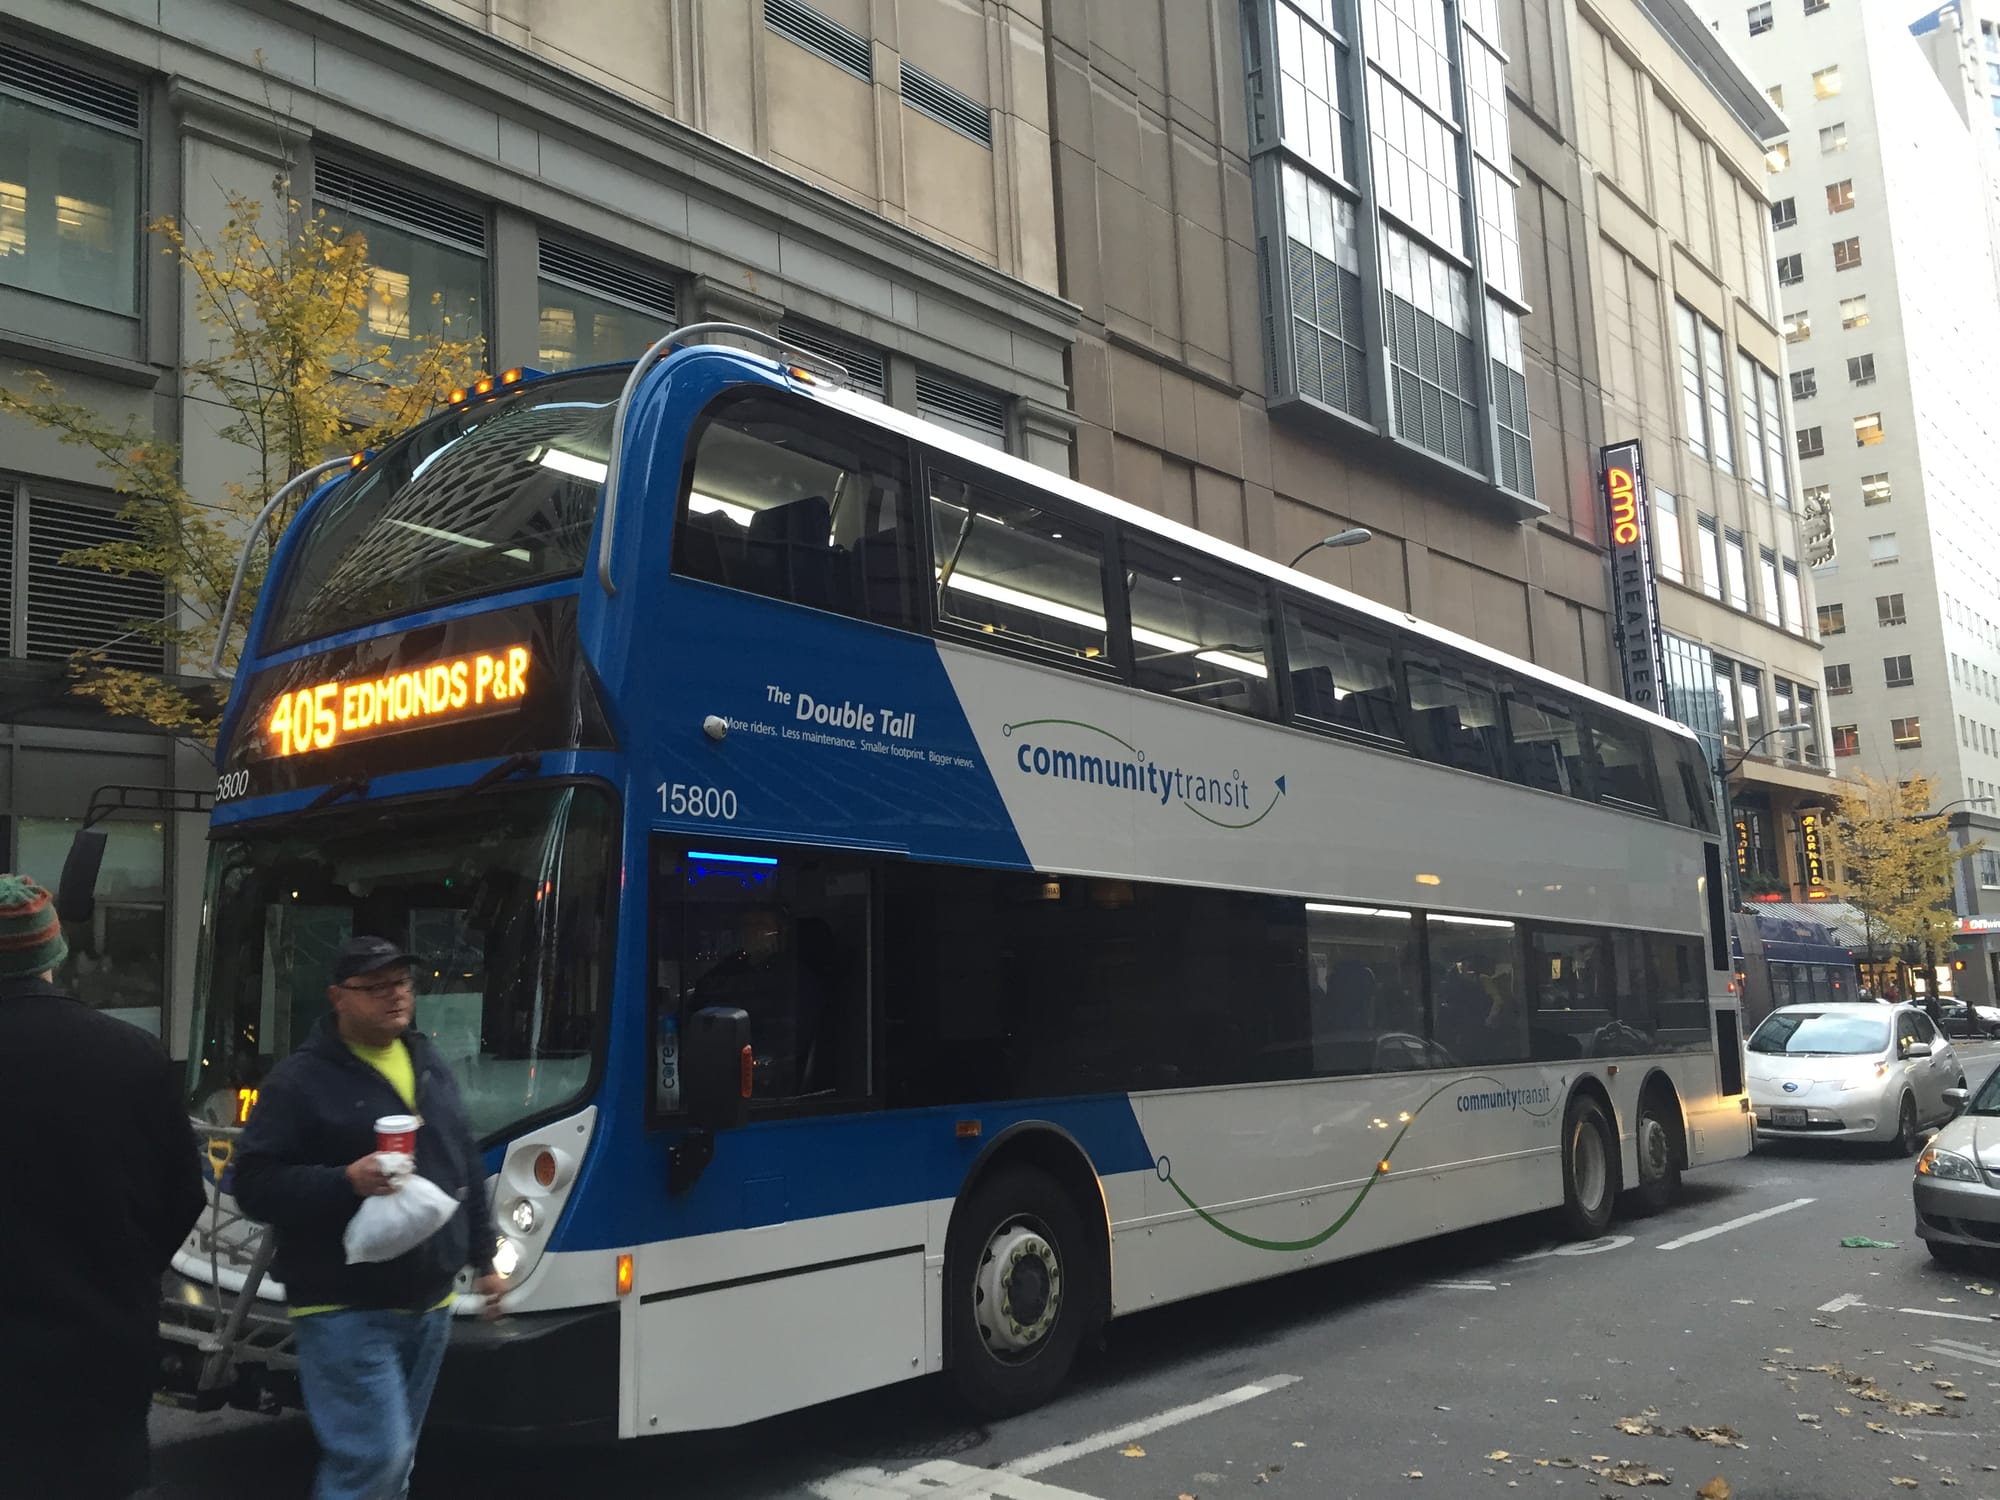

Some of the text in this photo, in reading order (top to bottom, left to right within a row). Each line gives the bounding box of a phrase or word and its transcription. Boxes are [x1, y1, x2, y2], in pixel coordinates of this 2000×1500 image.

[1608, 468, 1639, 544] amc
[1620, 550, 1651, 703] THEATRES
[269, 647, 528, 756] 405 EDMONDS P&R
[766, 685, 915, 740] The Double Tall
[725, 715, 975, 769] More riders. Less maintenance. Smaller footprint. Bigger views.
[656, 782, 738, 820] 15800
